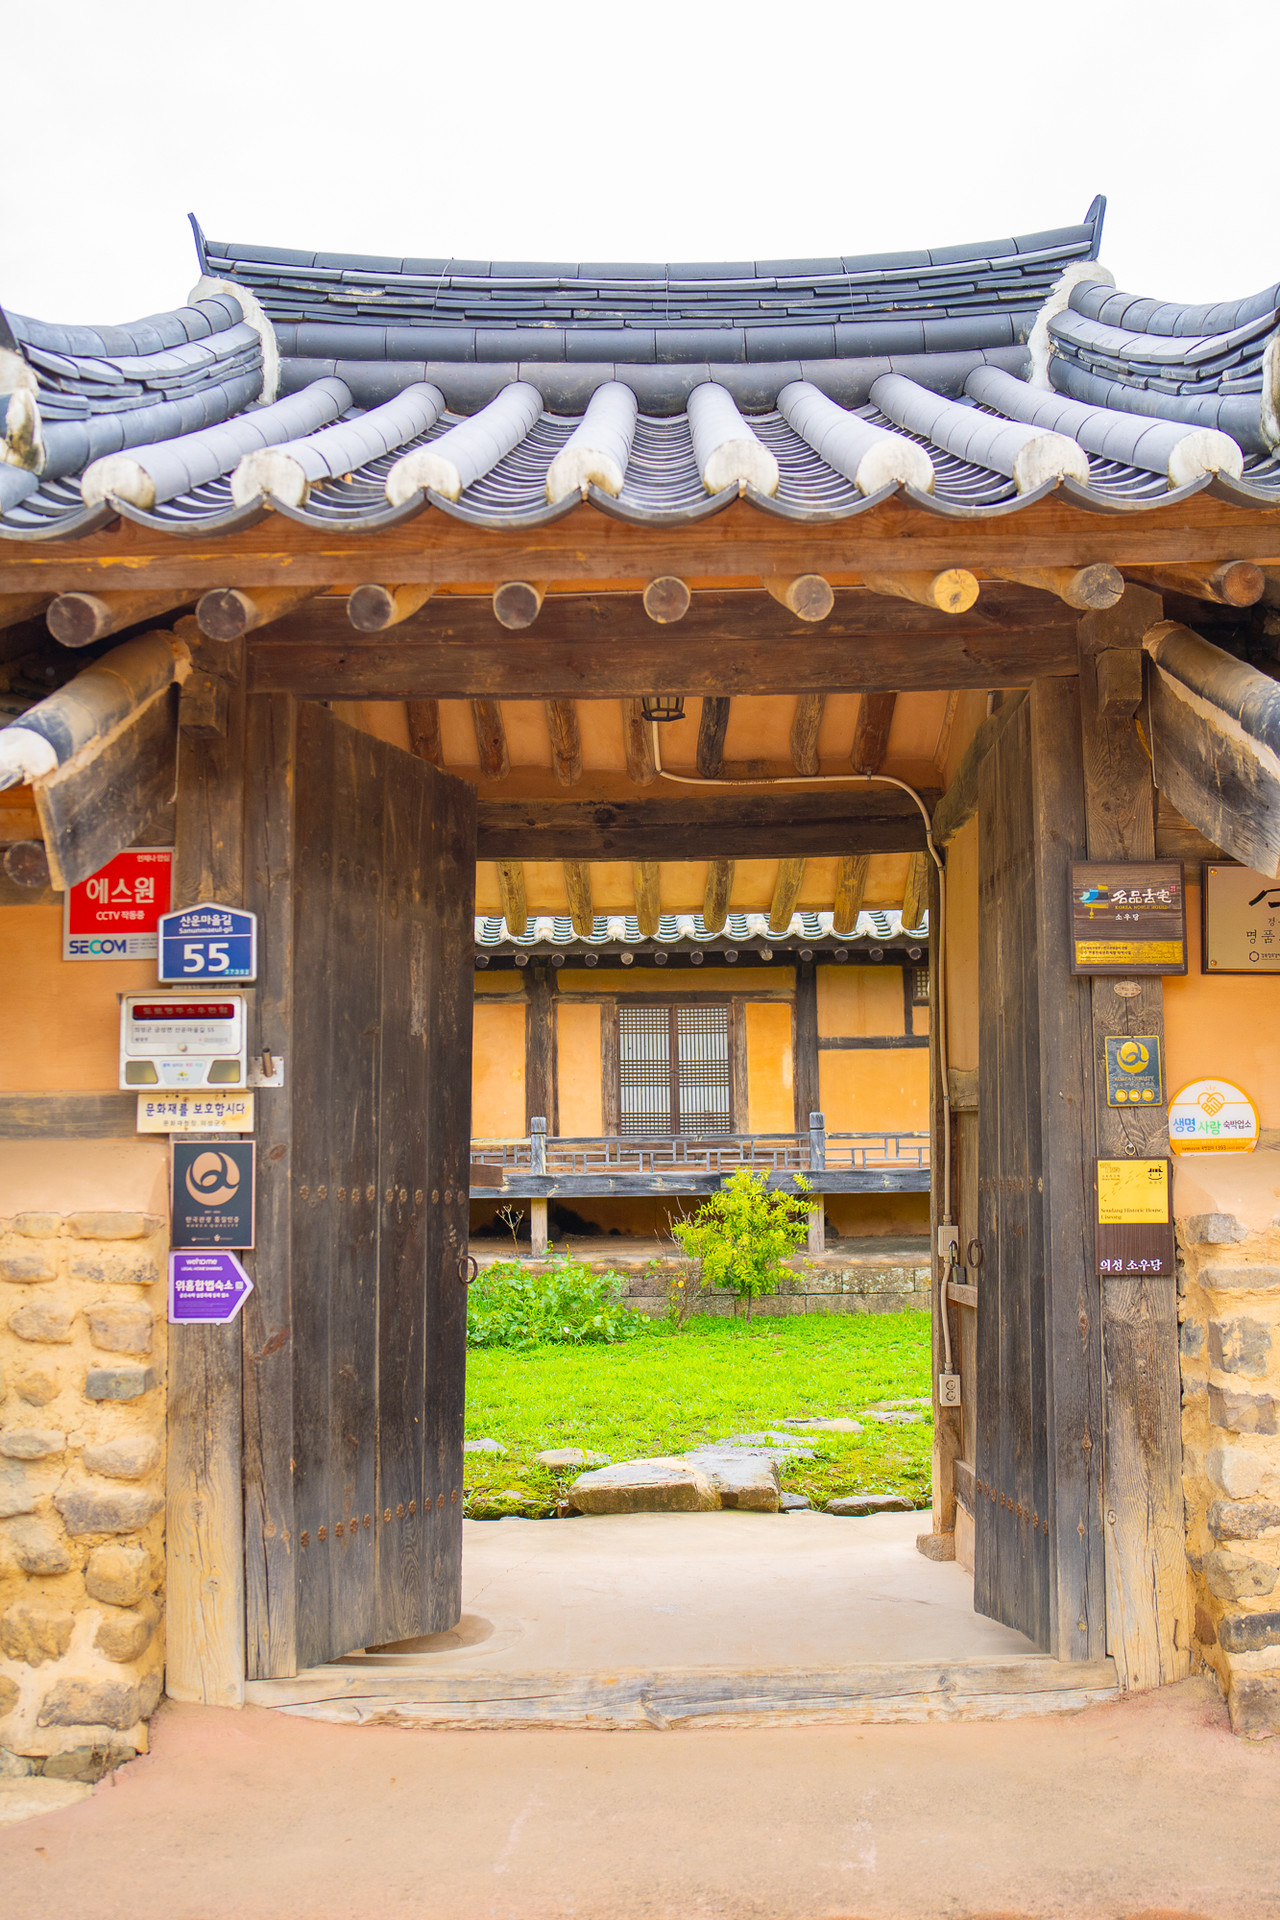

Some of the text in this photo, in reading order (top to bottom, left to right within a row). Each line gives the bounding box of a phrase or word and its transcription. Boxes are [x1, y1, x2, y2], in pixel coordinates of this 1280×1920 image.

[86, 877, 154, 904] 에스원
[1111, 888, 1172, 904] 名品古宅
[96, 910, 145, 920] CCTV 작동중
[180, 914, 232, 927] 산운마을길
[1115, 913, 1140, 921] 소우당
[69, 939, 127, 954] SECOM
[183, 943, 230, 973] 55
[146, 1103, 245, 1117] 문화재를 보호합시다
[1173, 1117, 1251, 1135] 생명 사랑 숙박업소
[1100, 1259, 1163, 1272] 의성 소우당
[175, 1280, 234, 1292] 위홈합법숙소
